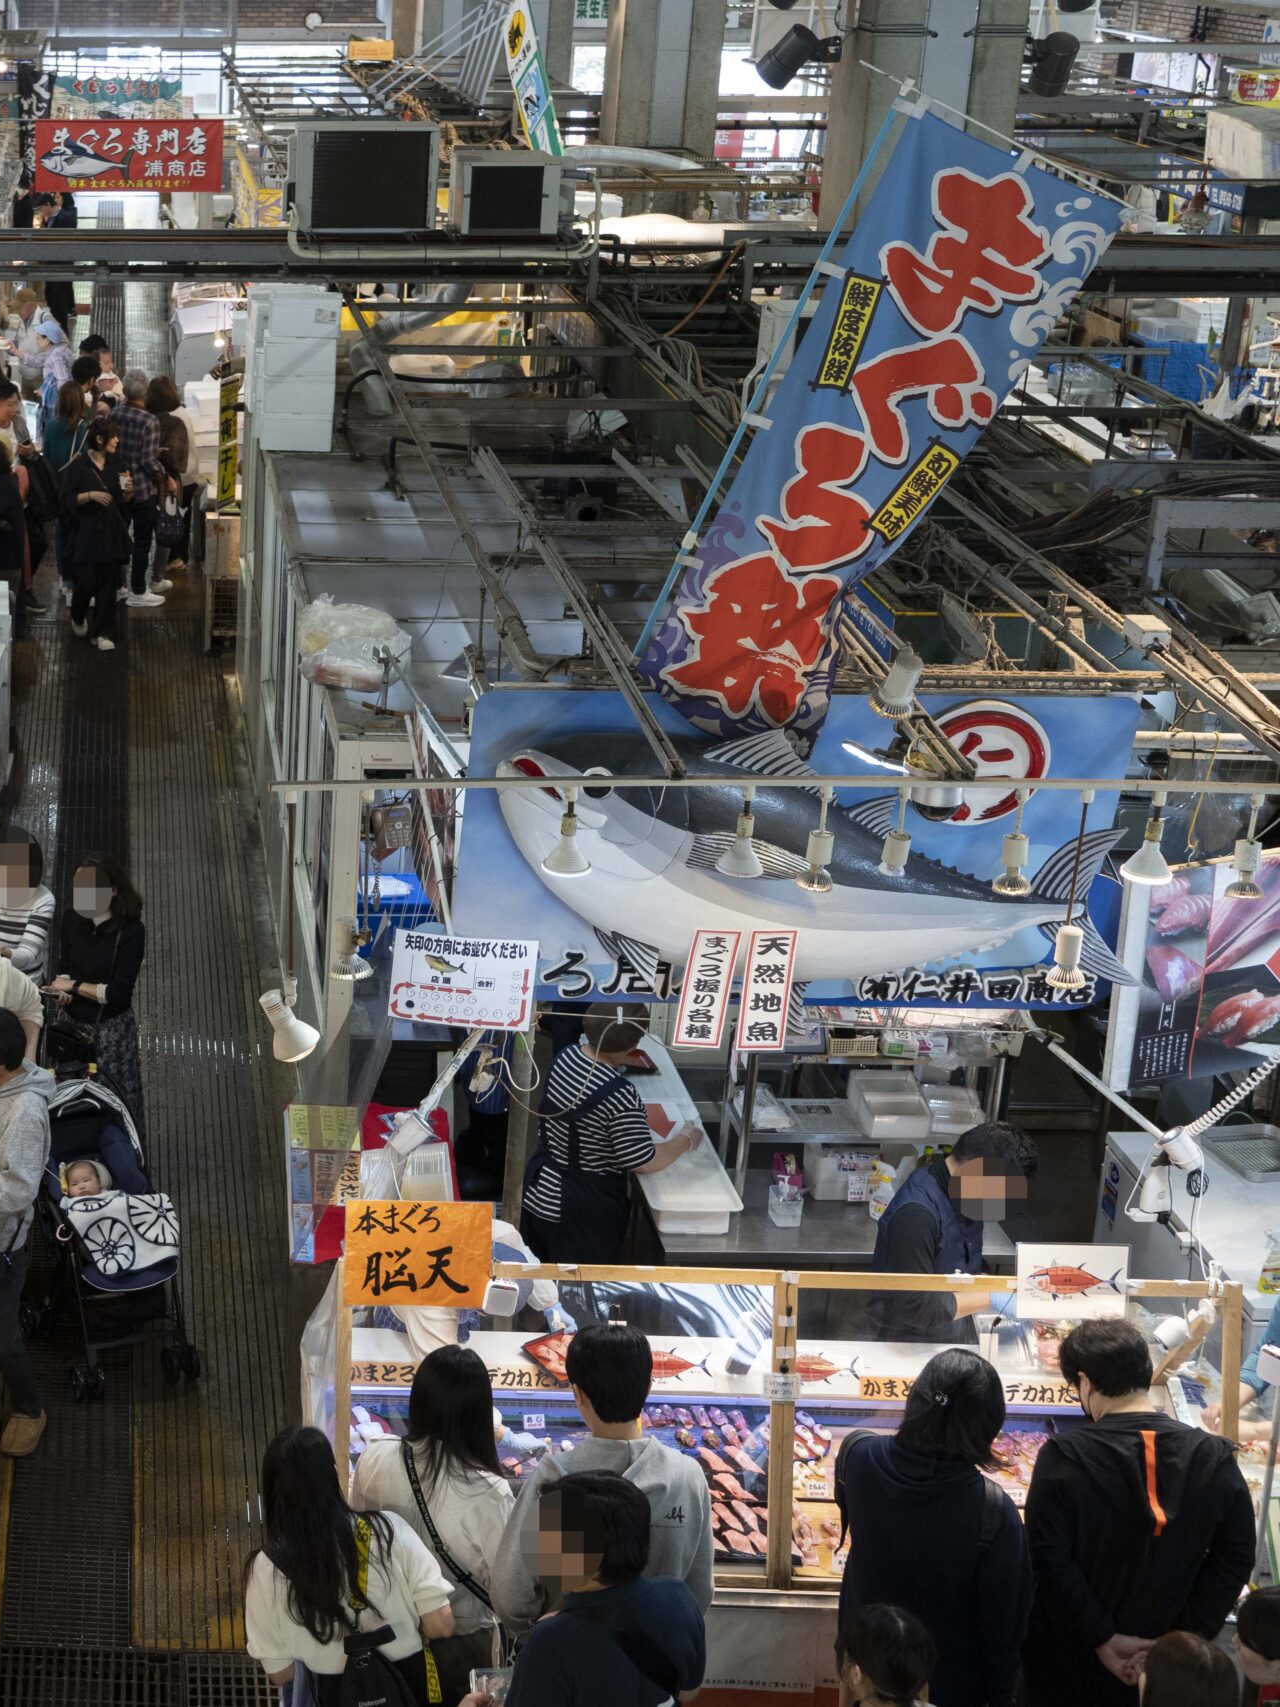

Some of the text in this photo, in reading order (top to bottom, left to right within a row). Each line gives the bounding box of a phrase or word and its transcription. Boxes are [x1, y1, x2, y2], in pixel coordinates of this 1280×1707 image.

[51, 126, 207, 156] まぐろ専門店
[144, 160, 207, 177] 浦商店
[819, 282, 876, 385] 鮮度抜群
[404, 932, 528, 959] 矢印の方向にお並びください
[684, 936, 727, 1040] まぐろ握り各種
[746, 936, 791, 1042] 天然地魚
[353, 1203, 442, 1236] 本まぐろ
[361, 1246, 470, 1297] 脳天
